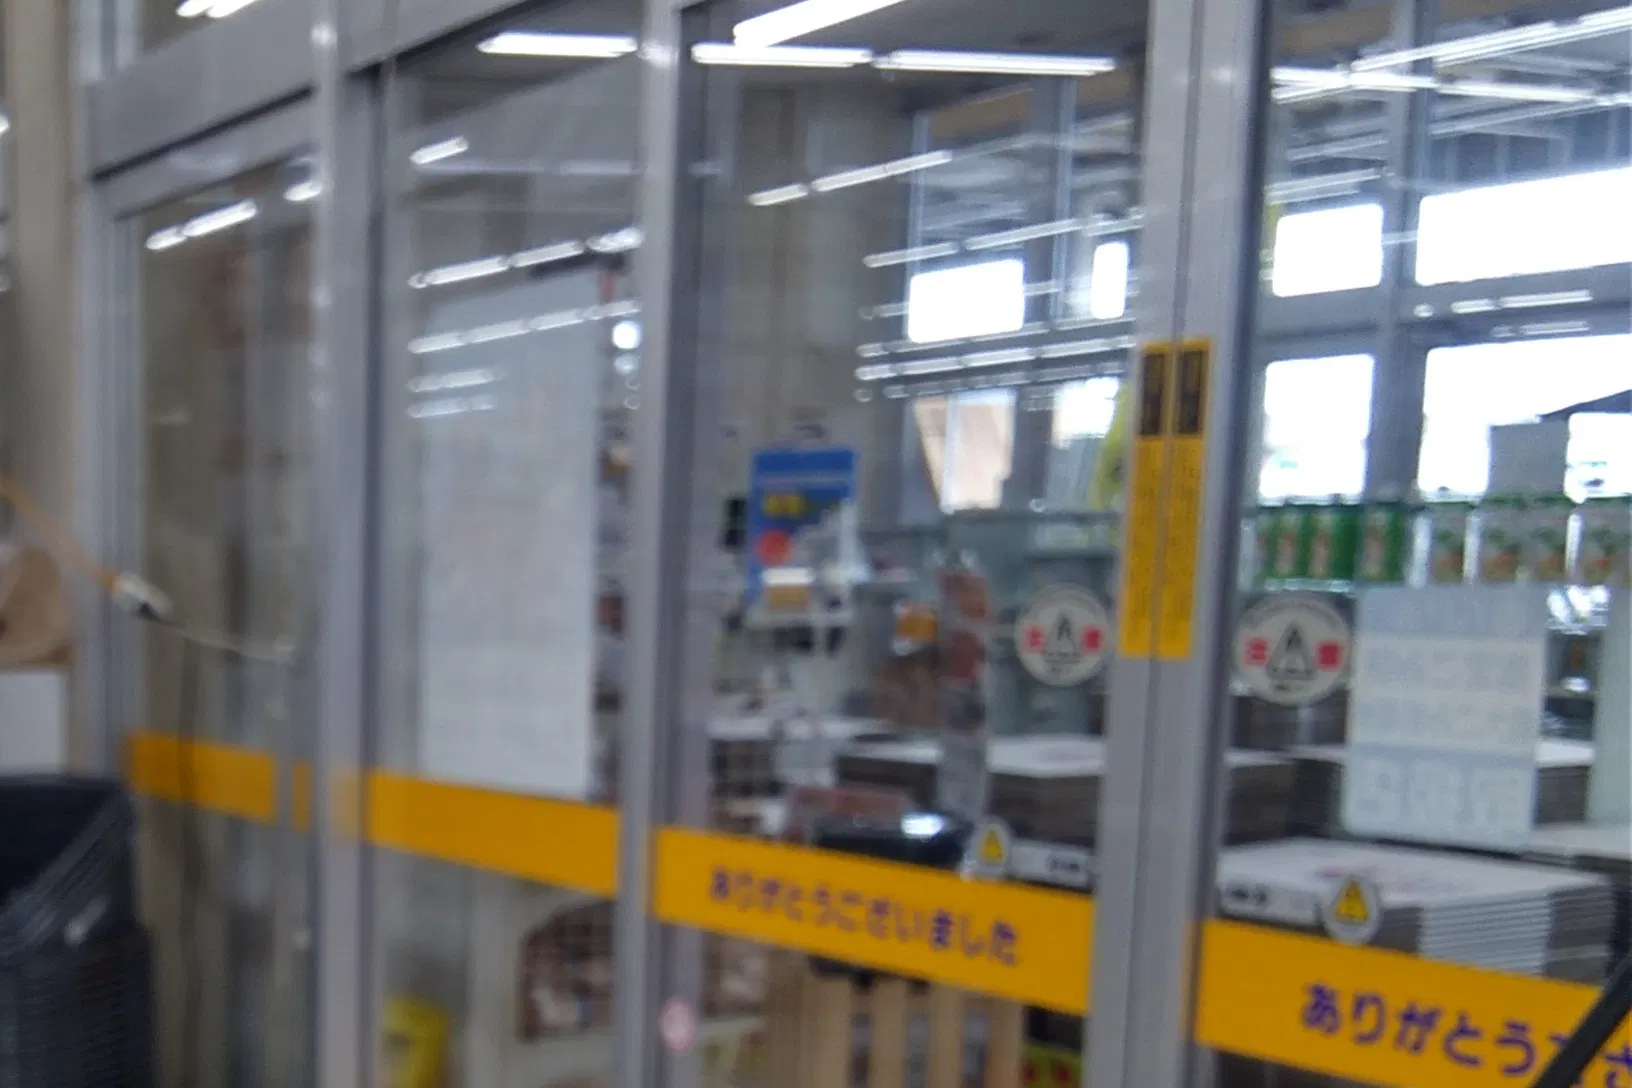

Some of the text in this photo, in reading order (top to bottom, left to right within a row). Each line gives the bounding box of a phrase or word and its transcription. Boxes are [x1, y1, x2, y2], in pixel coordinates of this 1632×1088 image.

[711, 864, 1018, 966] ありがとうございました
